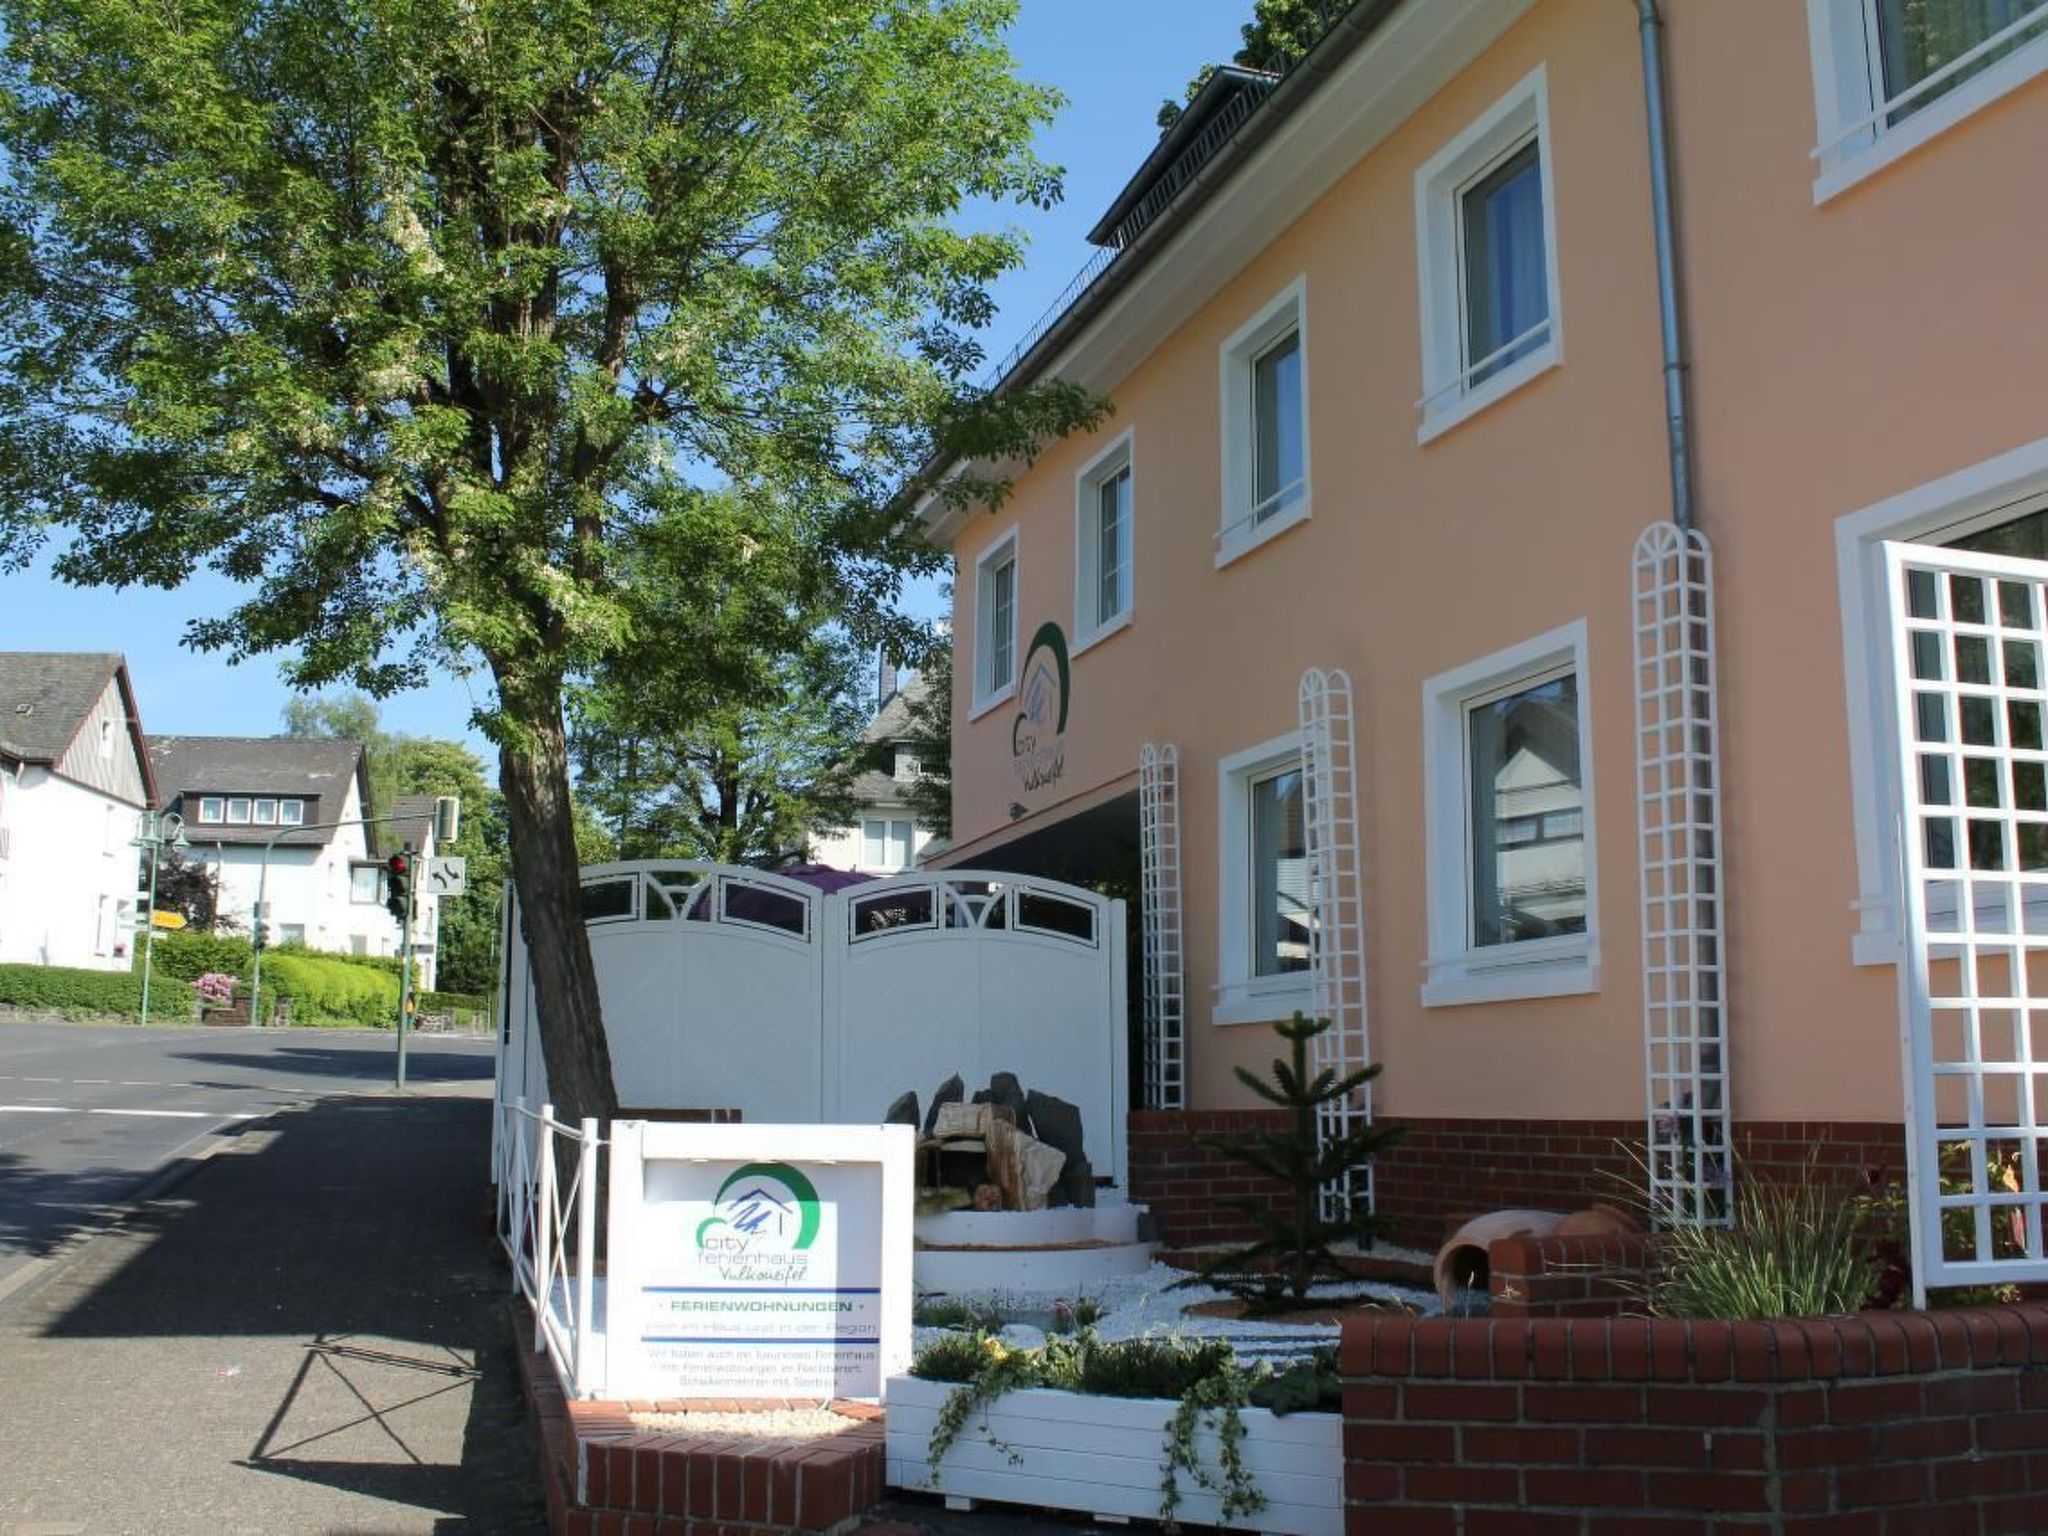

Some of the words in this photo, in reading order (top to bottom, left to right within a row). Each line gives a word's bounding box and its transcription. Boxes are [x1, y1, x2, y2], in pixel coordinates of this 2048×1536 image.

[705, 1236, 750, 1252] city
[698, 1250, 809, 1265] ferienhaus
[670, 1301, 853, 1312] FERIENWOHNUNGEN
